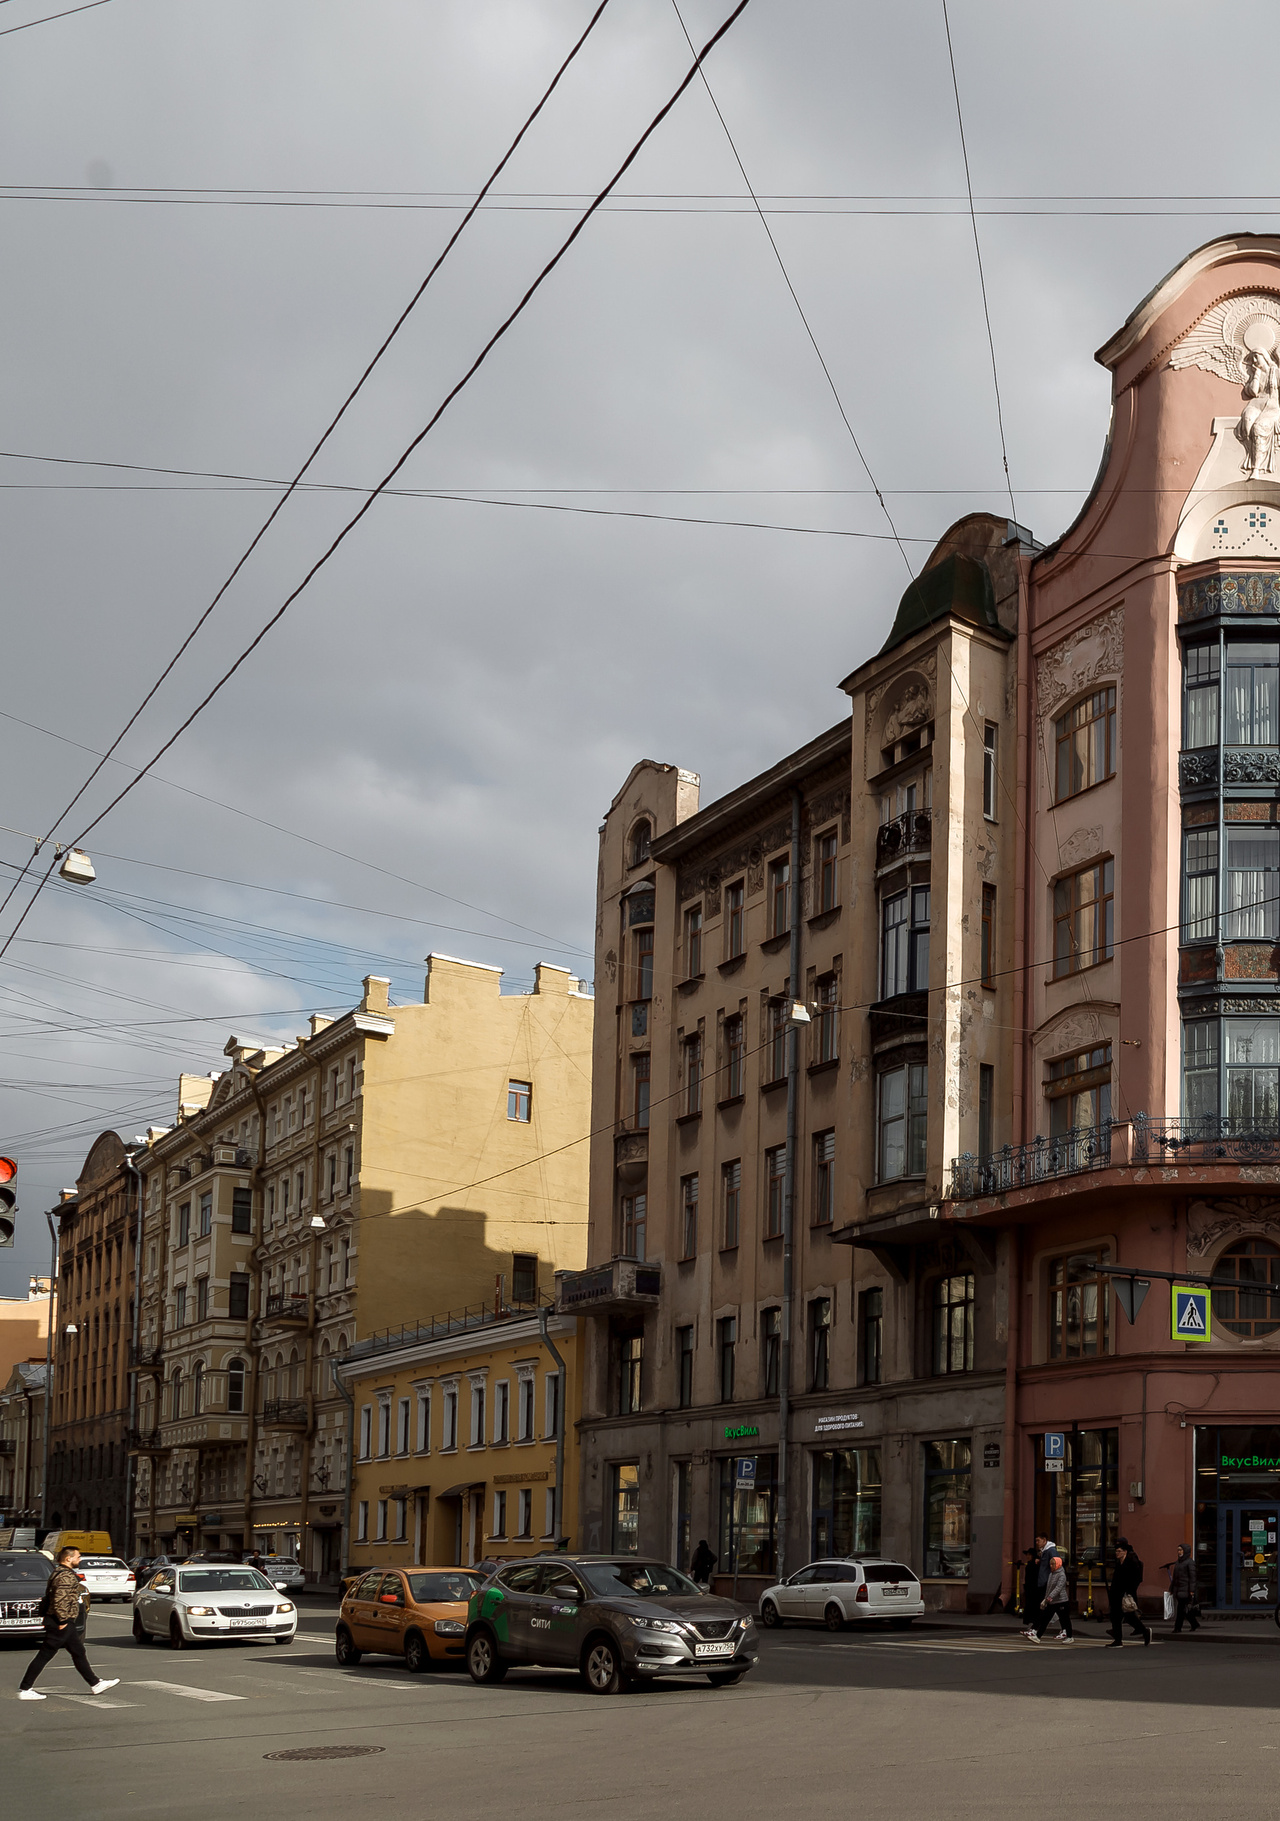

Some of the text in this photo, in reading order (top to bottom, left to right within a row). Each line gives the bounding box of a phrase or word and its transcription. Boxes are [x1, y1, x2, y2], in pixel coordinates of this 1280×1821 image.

[725, 1425, 758, 1439] ВкусВилл
[1050, 1436, 1061, 1455] P
[742, 1461, 753, 1477] P
